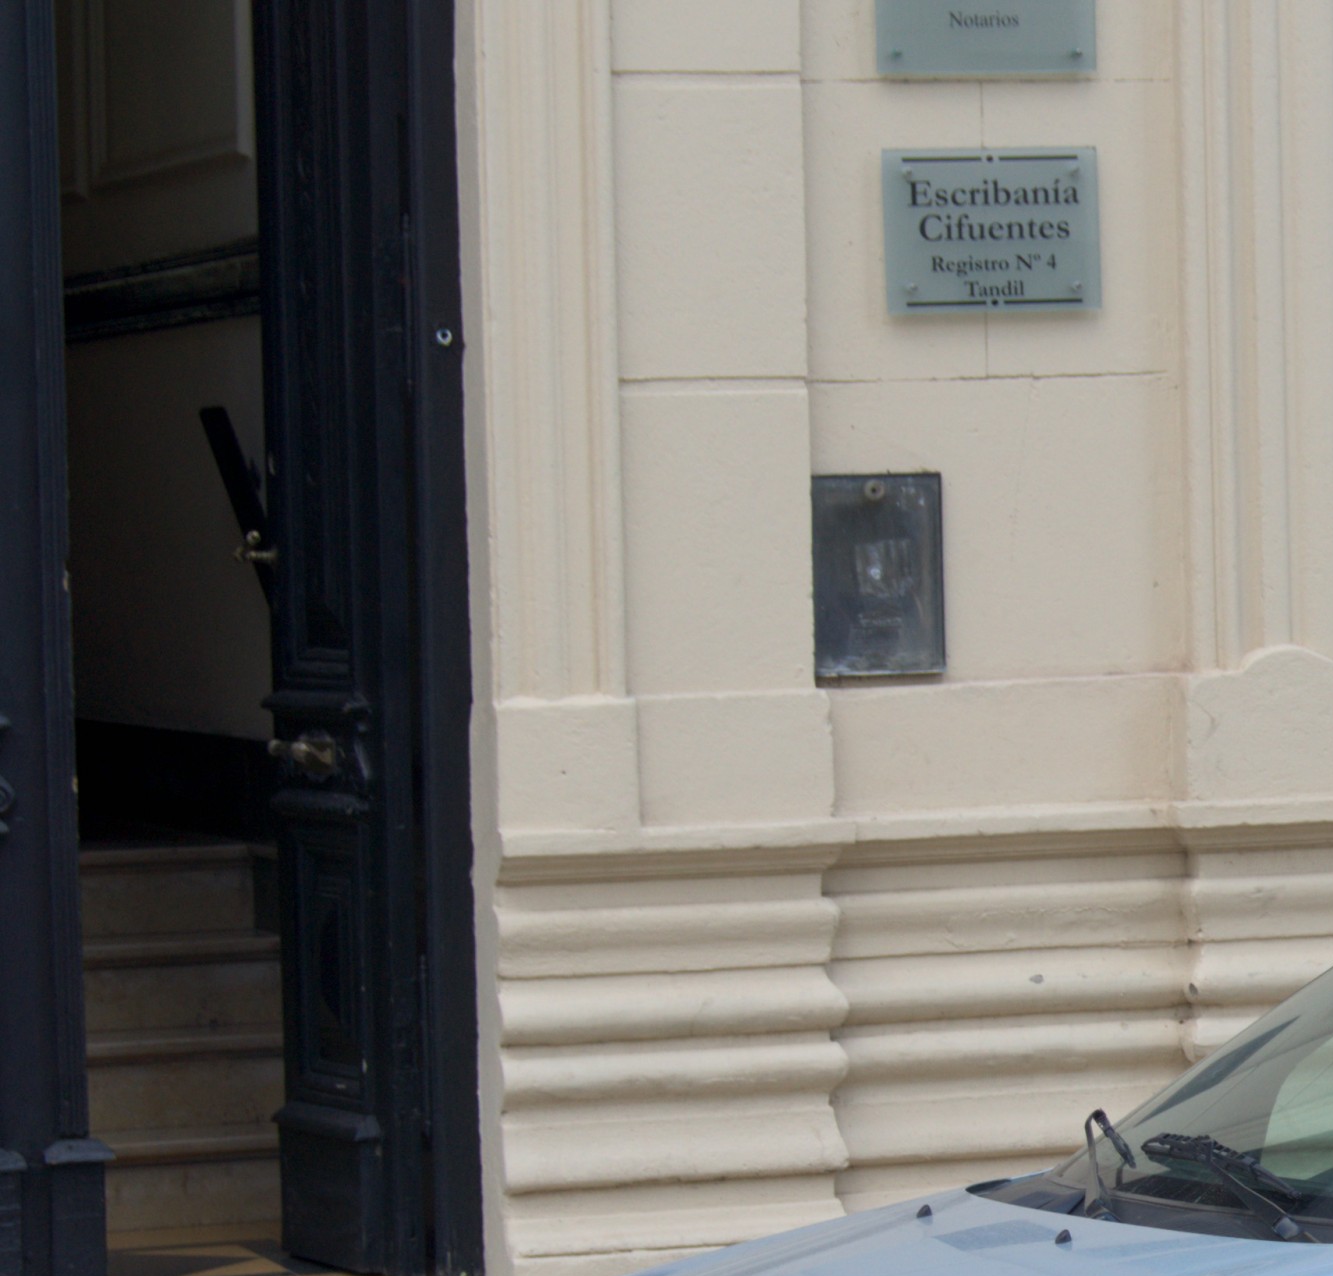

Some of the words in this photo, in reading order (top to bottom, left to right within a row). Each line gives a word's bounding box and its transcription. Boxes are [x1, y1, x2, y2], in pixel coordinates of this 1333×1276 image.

[948, 10, 1020, 28] Notarios
[908, 179, 1080, 208] Escribanía
[918, 214, 1071, 242] Cifuentes
[931, 255, 1010, 277] Registro
[1046, 254, 1058, 270] 4
[963, 280, 1025, 297] Tandil
